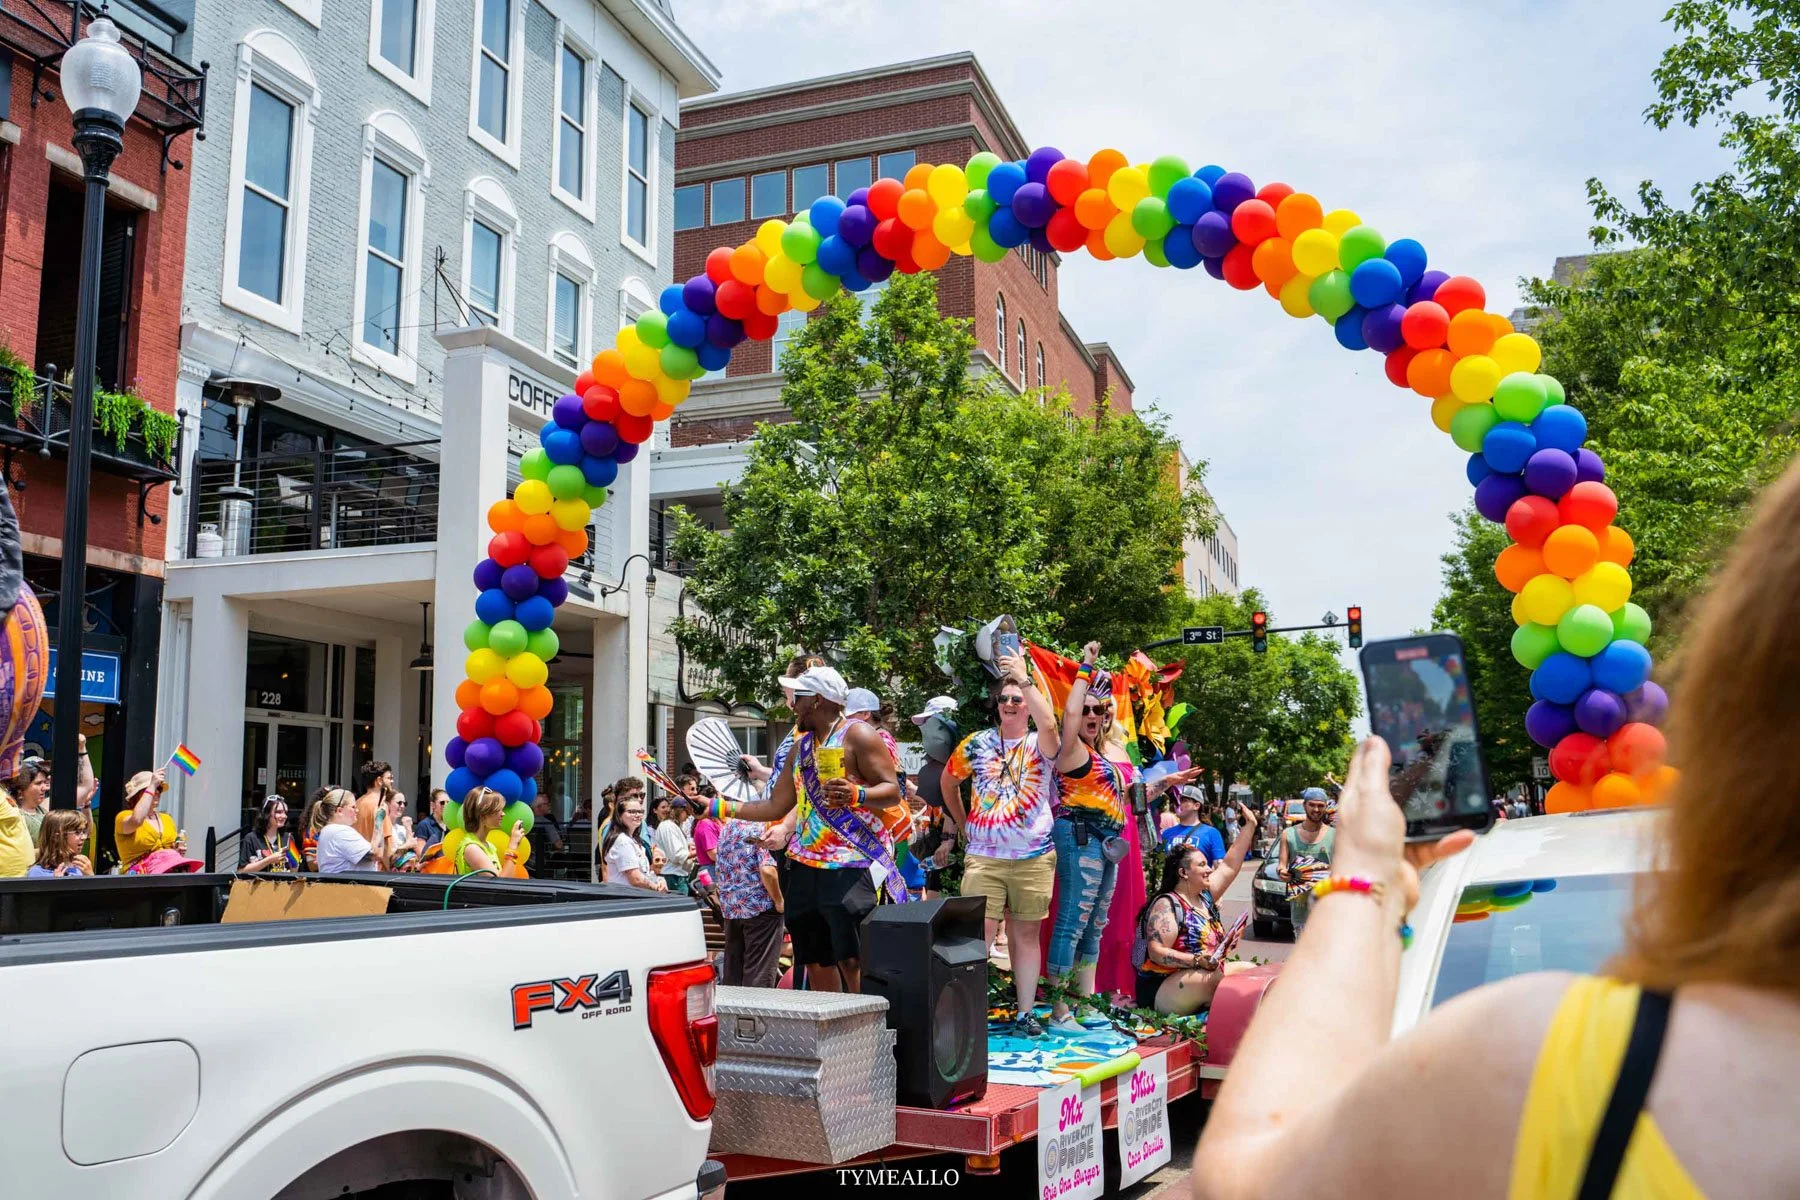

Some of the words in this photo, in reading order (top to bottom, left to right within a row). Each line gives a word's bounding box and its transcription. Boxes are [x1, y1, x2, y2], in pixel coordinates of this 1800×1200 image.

[1206, 631, 1218, 640] St
[80, 669, 105, 683] INE
[261, 691, 282, 706] 228
[511, 969, 632, 1031] FX4
[582, 1011, 603, 1020] OFF
[606, 1005, 632, 1016] ROAD
[1131, 1070, 1156, 1104] Miss
[1059, 1094, 1083, 1132] Mx
[1136, 1110, 1162, 1141] PRIDE
[1059, 1137, 1094, 1173] PRIDE
[1074, 1165, 1100, 1186] Burger
